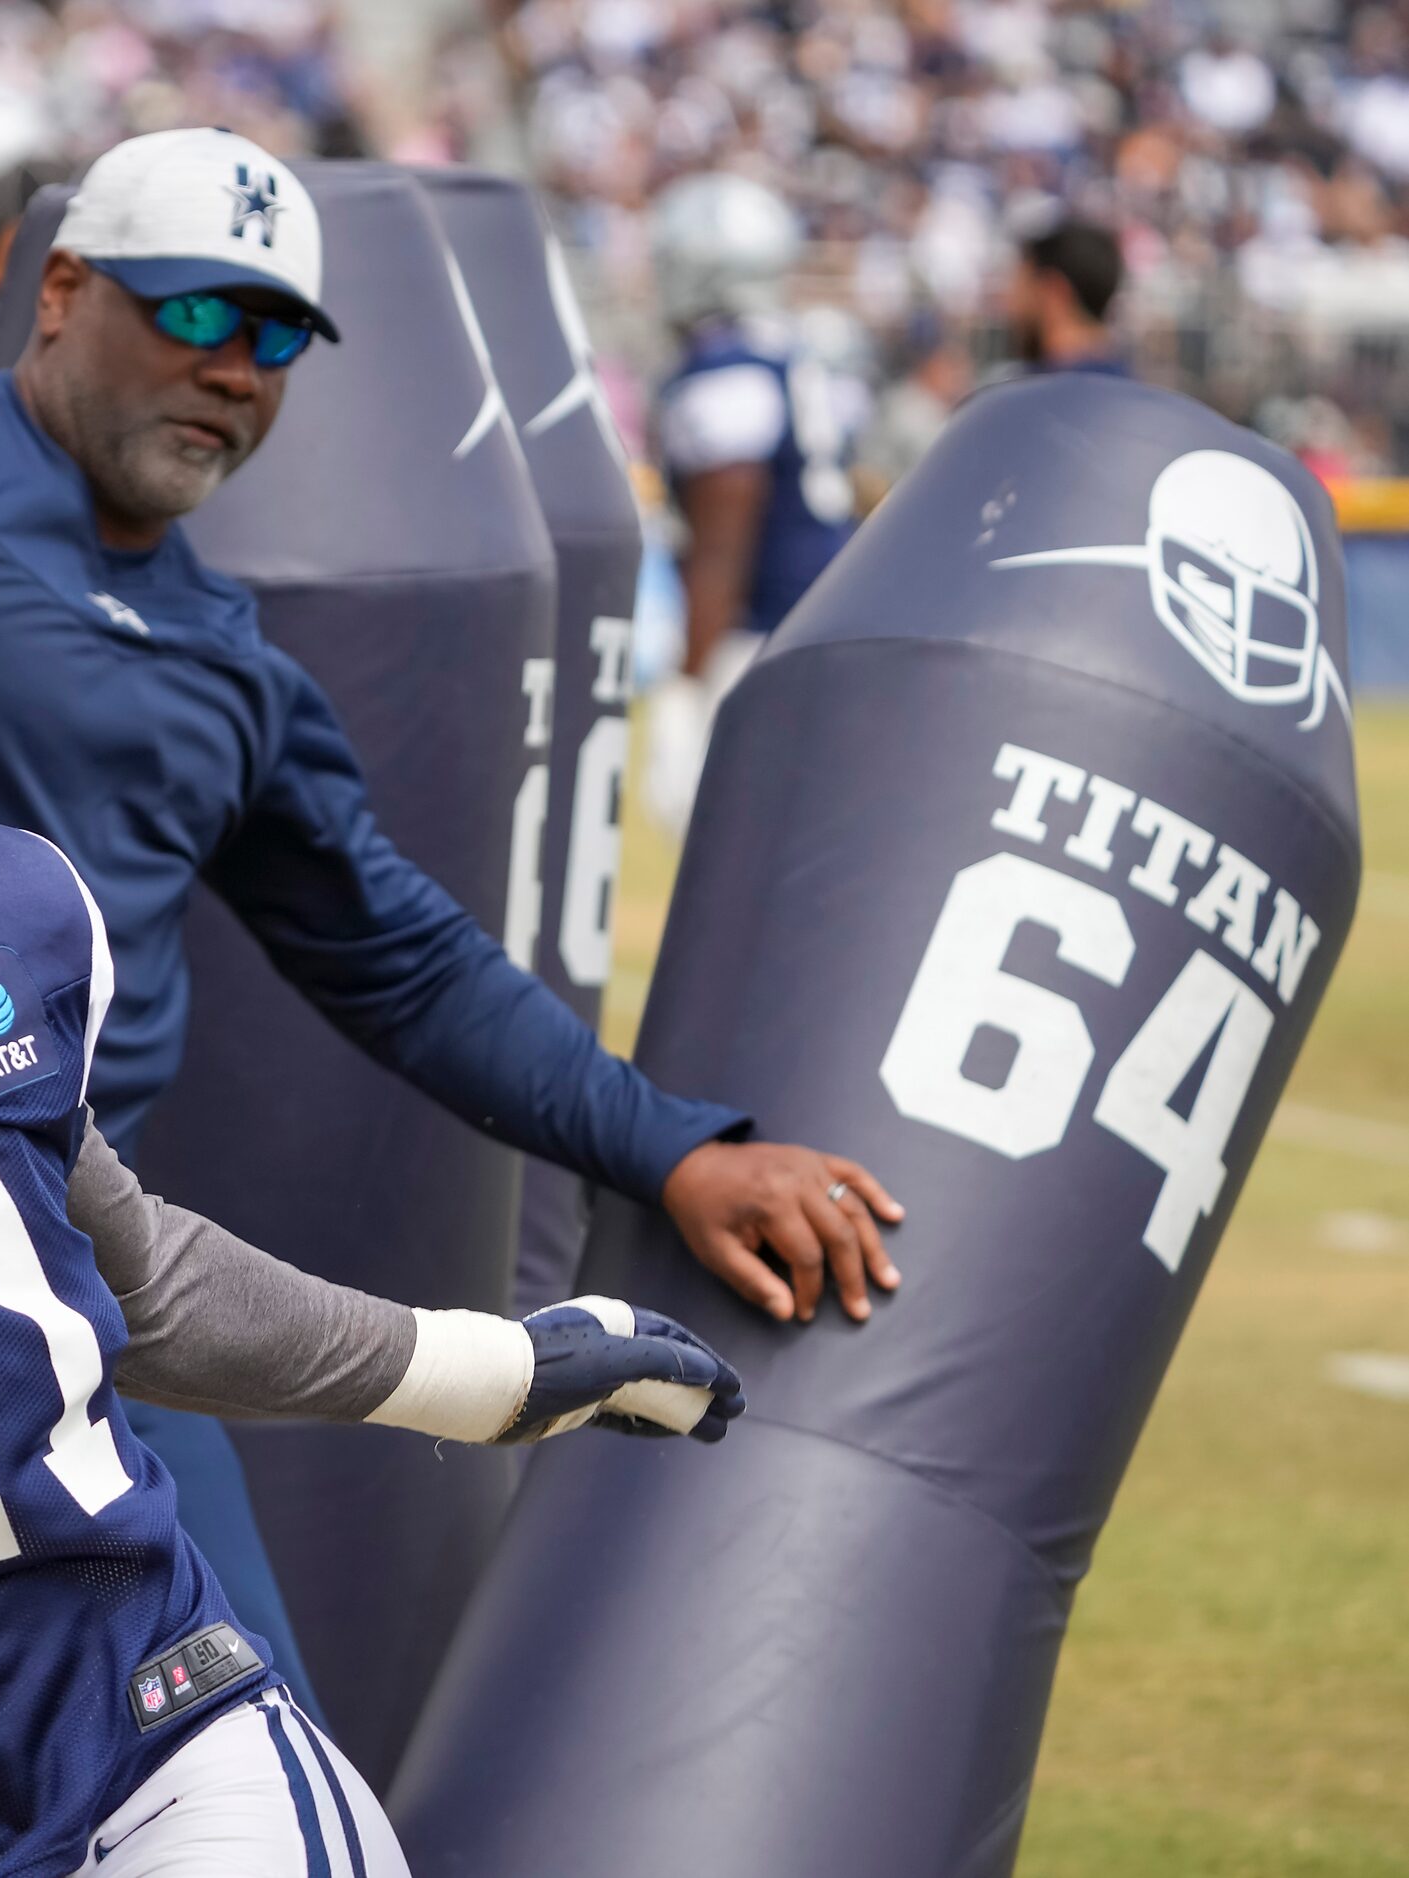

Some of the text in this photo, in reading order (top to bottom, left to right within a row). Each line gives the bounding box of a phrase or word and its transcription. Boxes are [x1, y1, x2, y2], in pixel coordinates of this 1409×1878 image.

[990, 742, 1321, 1006] TITAN
[878, 851, 1276, 1275] 64
[193, 1638, 220, 1666] 50
